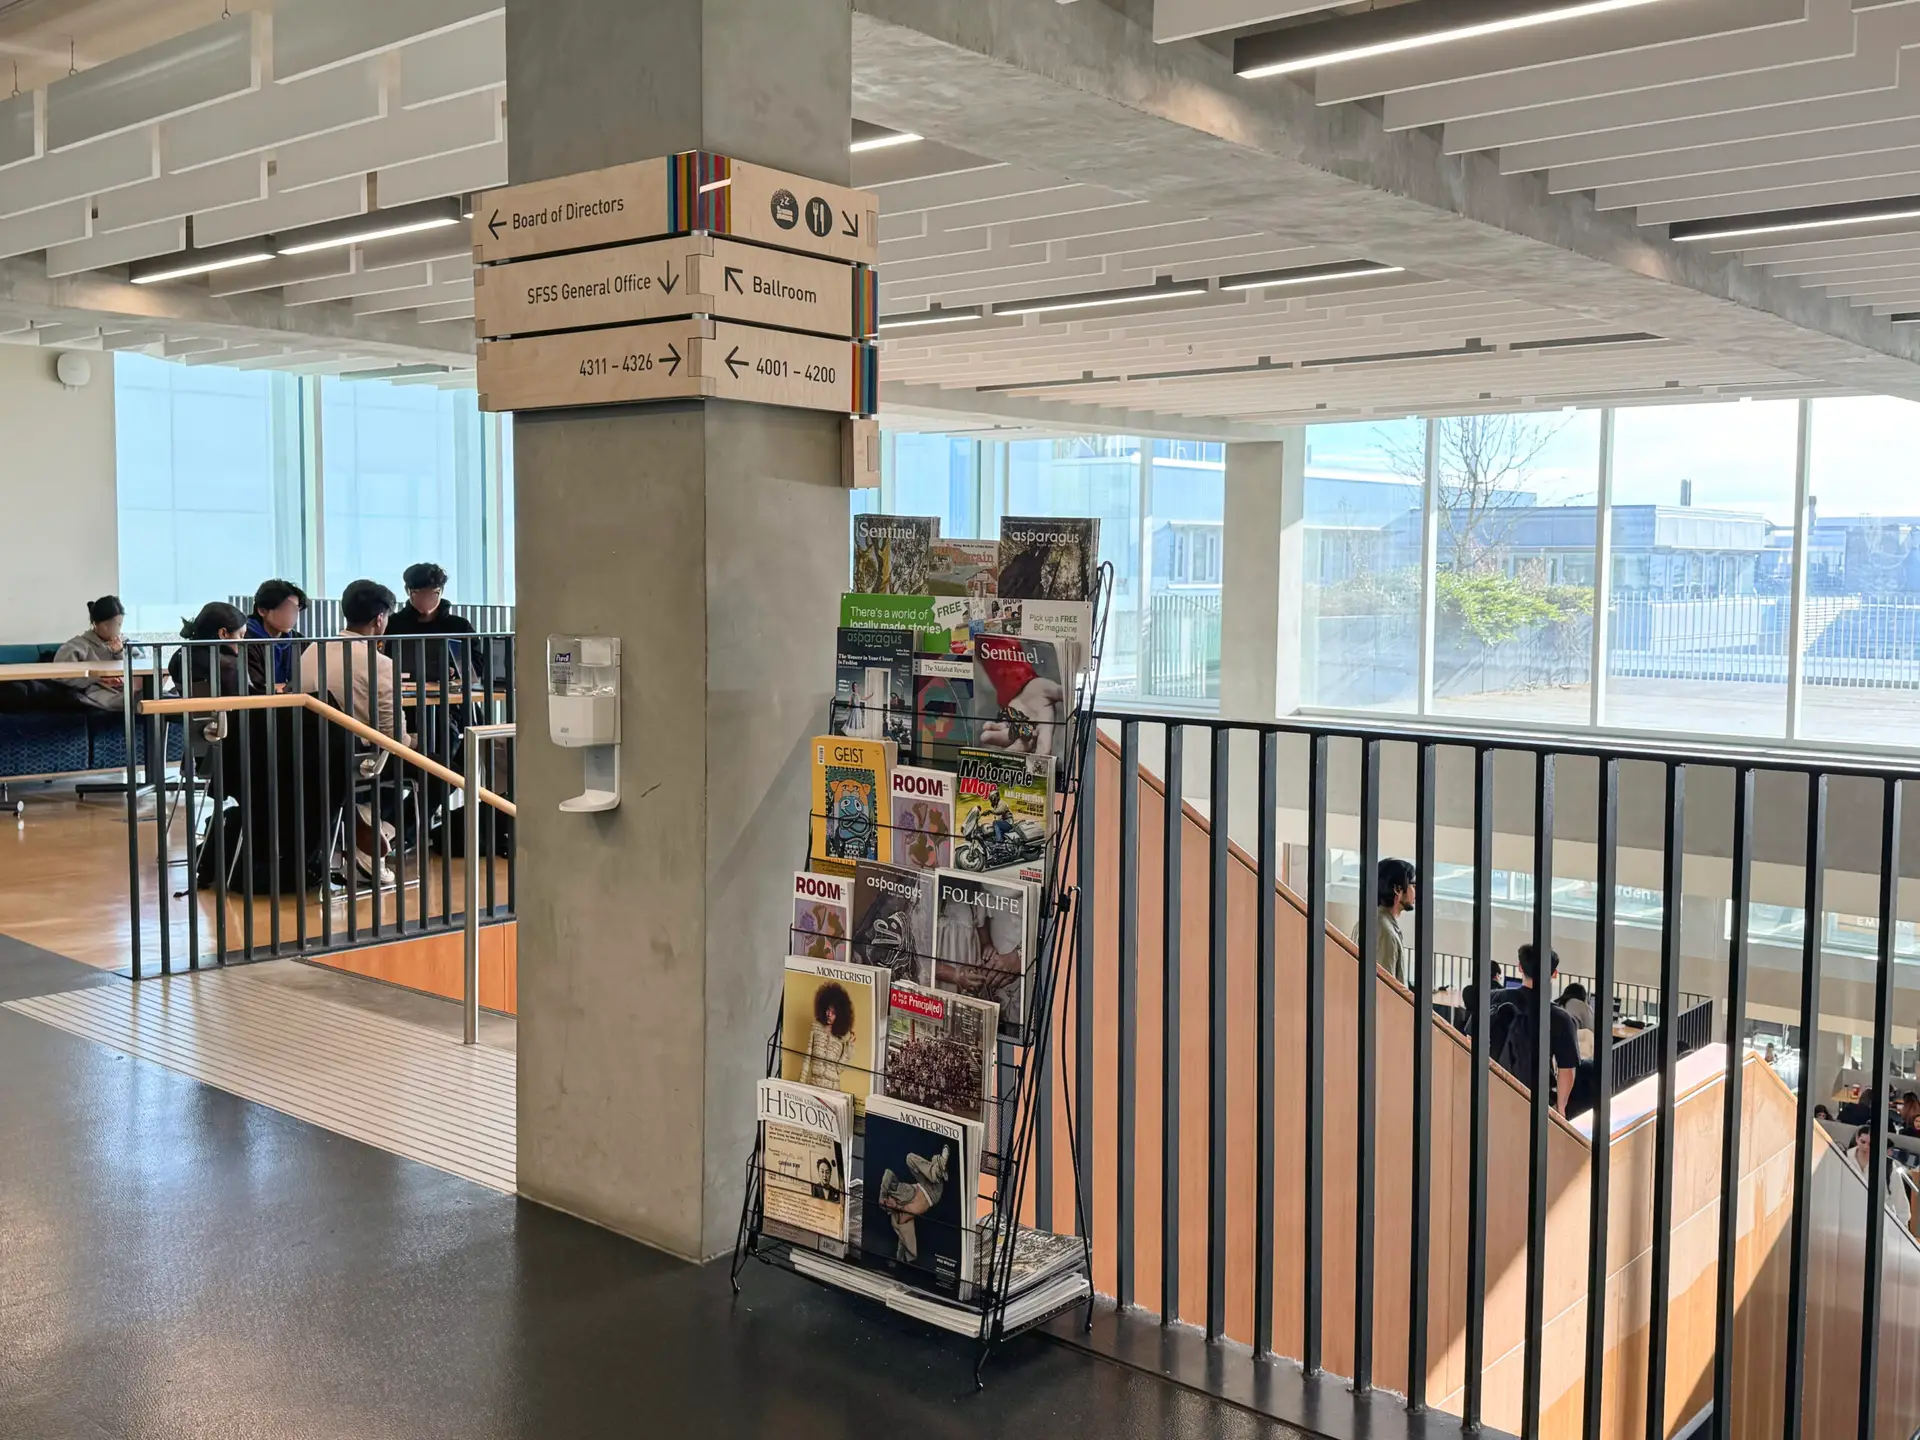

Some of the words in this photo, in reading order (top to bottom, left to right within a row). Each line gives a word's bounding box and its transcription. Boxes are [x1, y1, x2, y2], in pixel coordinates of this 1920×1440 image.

[512, 206, 547, 230] Board
[549, 204, 563, 223] of
[565, 196, 624, 222] Directors
[527, 285, 559, 304] SFSS
[561, 277, 611, 300] General
[614, 274, 651, 294] Office
[752, 276, 817, 303] Ballroom
[579, 359, 608, 377] 4311
[622, 353, 654, 372] 4326
[756, 358, 790, 377] 4001
[804, 364, 836, 384] 4200
[1011, 528, 1080, 547] asparagus
[850, 606, 883, 618] There's
[884, 609, 890, 618] a
[891, 608, 916, 620] world
[918, 609, 929, 620] of
[937, 600, 962, 618] FREE
[1029, 613, 1044, 622] Pick
[1044, 615, 1054, 624] up
[1060, 615, 1078, 623] FREE
[850, 619, 881, 630] locally
[881, 620, 906, 631] made
[908, 622, 941, 635] stories
[1033, 623, 1044, 631] BC
[1044, 624, 1078, 634] magazine
[847, 630, 903, 648] asparagus
[924, 664, 933, 672] The
[834, 746, 864, 764] GEIST
[960, 758, 1033, 788] Motorcycle
[893, 773, 943, 798] ROOM
[796, 876, 841, 901] ROOM
[866, 876, 923, 899] asparagus
[942, 885, 1020, 914] FOLKLIFE
[816, 966, 872, 985] MONTECRISTO
[908, 995, 943, 1018] Principl(ed)
[900, 1111, 960, 1139] MONTECRISTO
